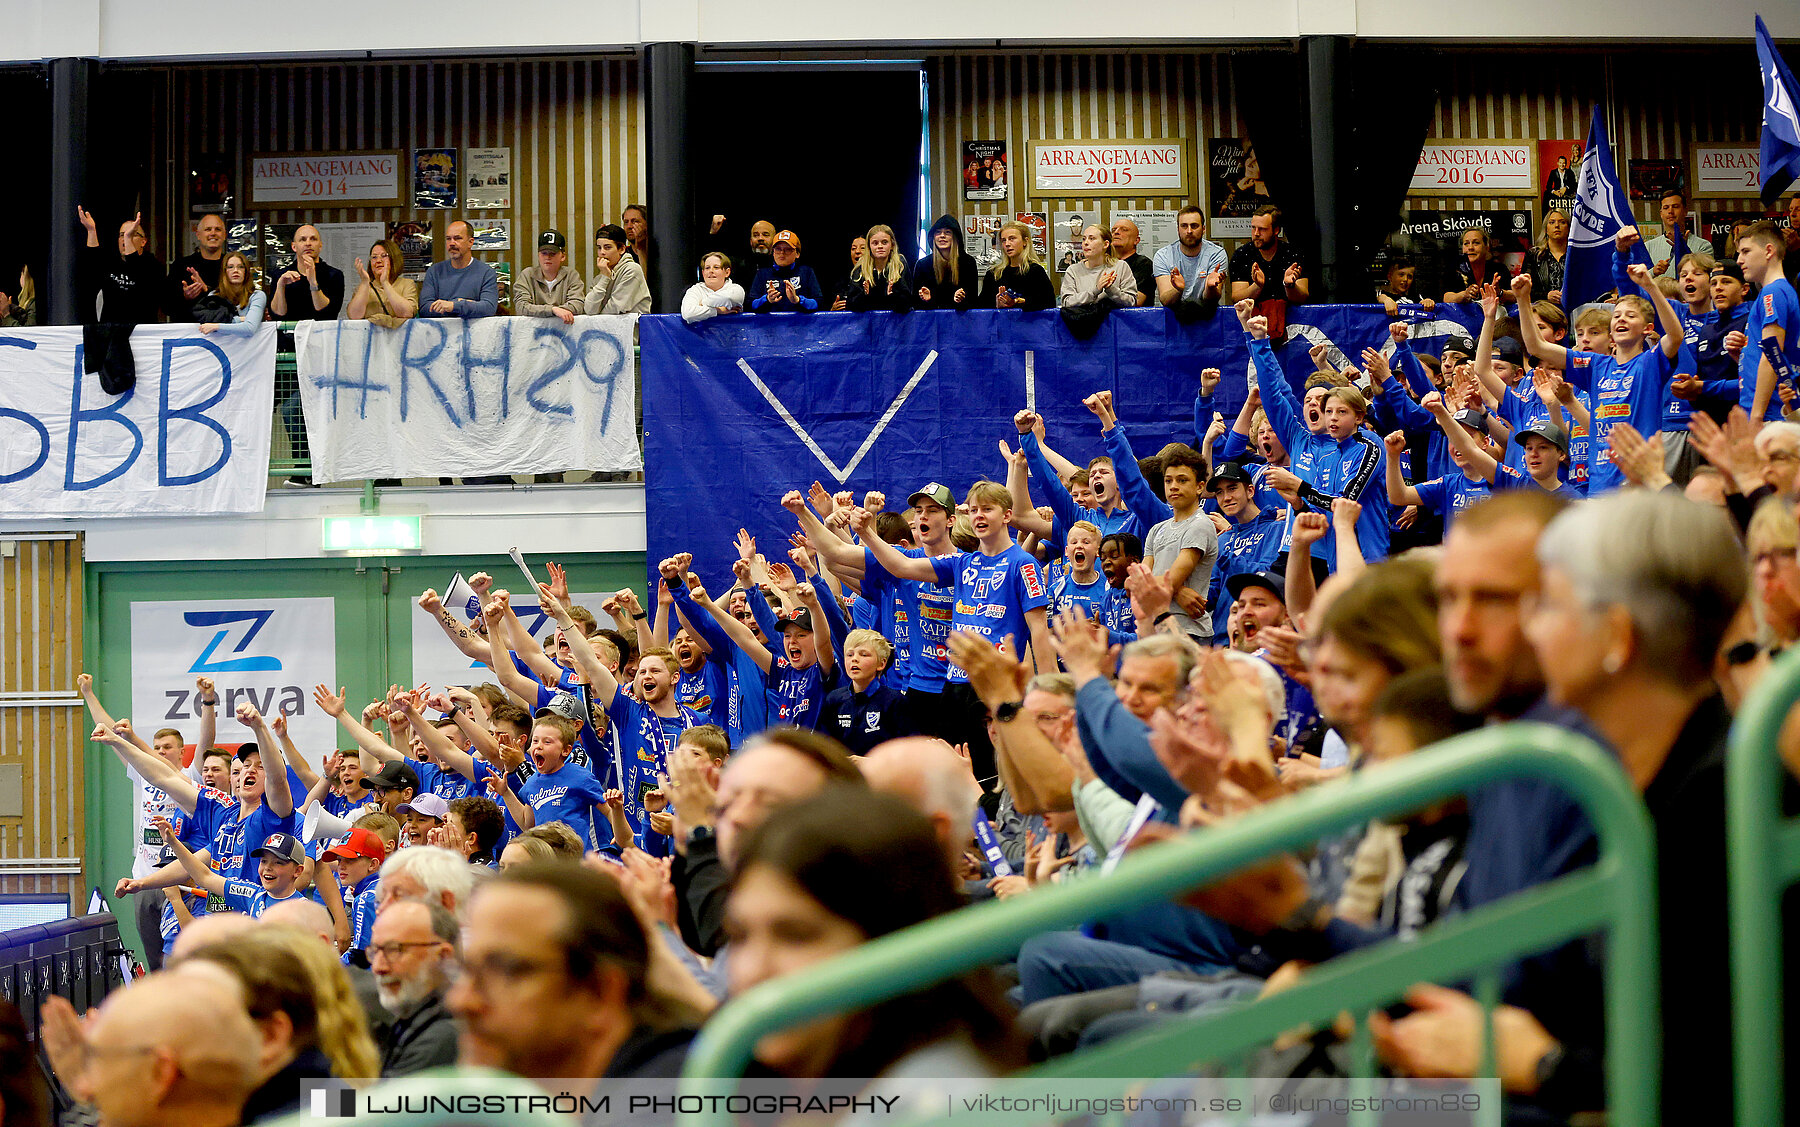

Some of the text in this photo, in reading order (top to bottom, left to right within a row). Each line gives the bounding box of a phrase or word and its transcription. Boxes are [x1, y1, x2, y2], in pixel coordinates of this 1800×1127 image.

[968, 143, 1001, 151] CHRISTMAS
[975, 150, 995, 159] NIGHT
[1217, 145, 1244, 157] Min
[1039, 149, 1177, 166] ARRANGEMANG
[1212, 154, 1237, 167] bästa
[1417, 149, 1527, 166] RANGEMANG
[1702, 152, 1761, 170] ARRAN
[255, 158, 393, 179] ARRANGEMANG
[1084, 167, 1133, 186] 2015
[1219, 162, 1241, 179] jul
[1436, 166, 1485, 185] 2016
[299, 176, 348, 196] 2014
[1584, 166, 1599, 200] IFK
[1548, 198, 1577, 208] CHRIS
[1573, 198, 1605, 233] ÖVDE
[1400, 222, 1441, 235] Arena
[1443, 215, 1492, 232] Skövde
[1710, 223, 1732, 235] Are
[1435, 230, 1463, 239] Evenem
[308, 318, 626, 437] #RH29
[1453, 494, 1466, 507] 29
[962, 566, 979, 586] 62
[1023, 564, 1041, 597] MAXI
[1056, 595, 1073, 612] 35
[986, 610, 1004, 618] SPORT
[919, 619, 953, 638] RAPP
[681, 683, 692, 694] 85
[164, 684, 305, 721] zerva
[529, 785, 569, 807] Salming
